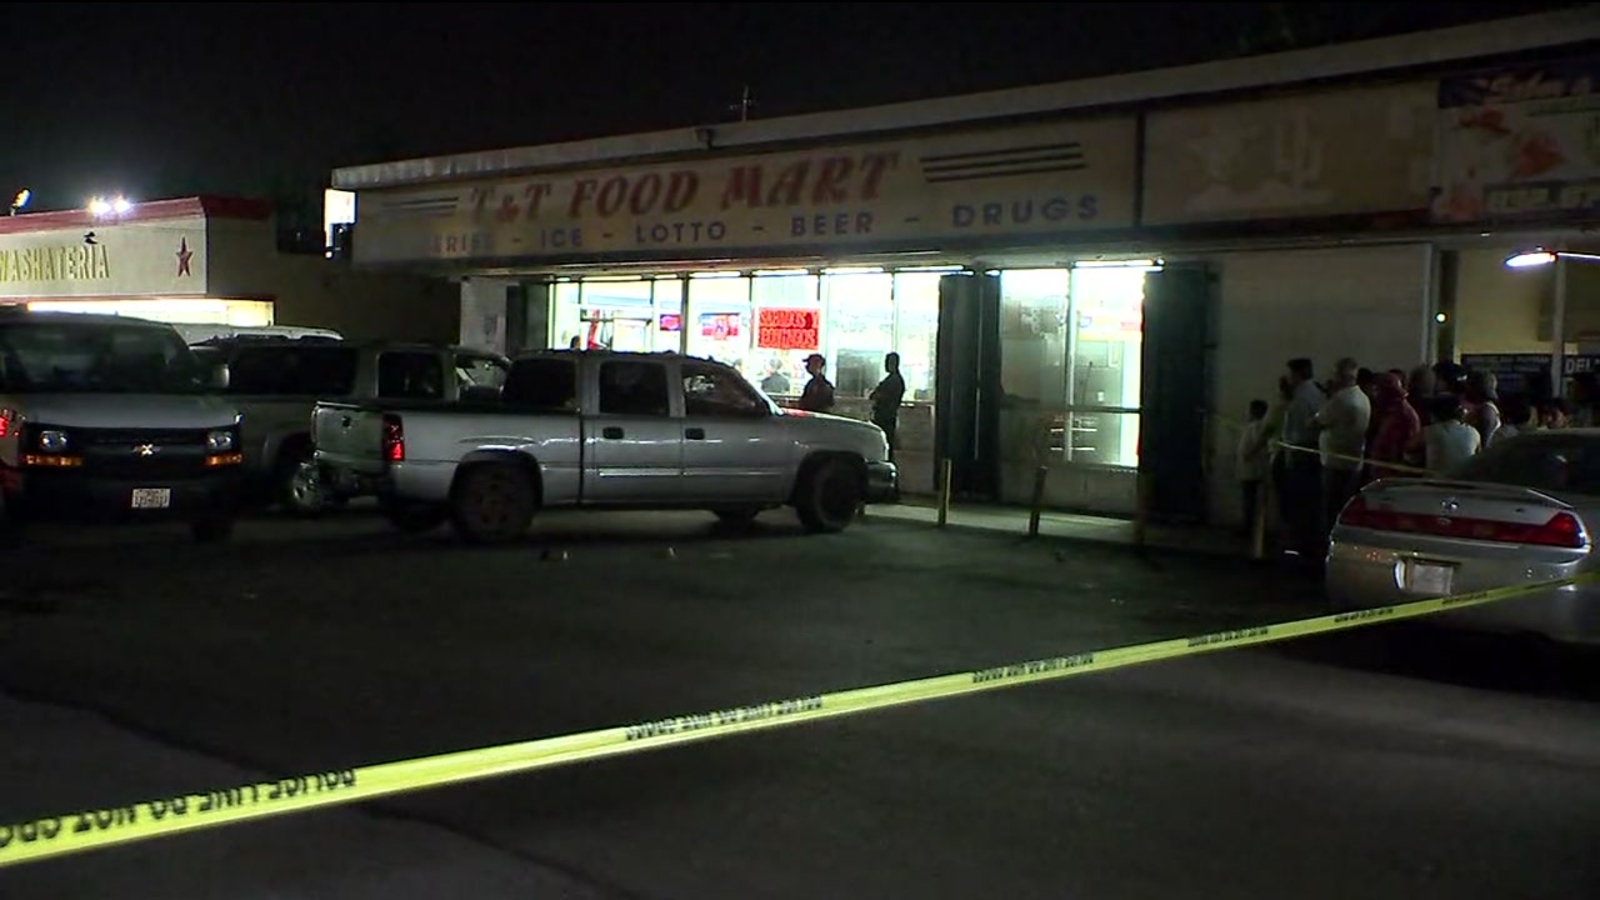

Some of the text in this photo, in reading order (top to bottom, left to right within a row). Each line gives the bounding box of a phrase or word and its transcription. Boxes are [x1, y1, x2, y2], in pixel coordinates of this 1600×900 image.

[470, 151, 899, 225] T&T FOOD MART
[540, 228, 582, 249] ICE
[635, 220, 727, 243] LOTTO
[791, 211, 874, 237] BEER
[952, 194, 1099, 227] DRUGS
[1565, 357, 1600, 375] DEL
